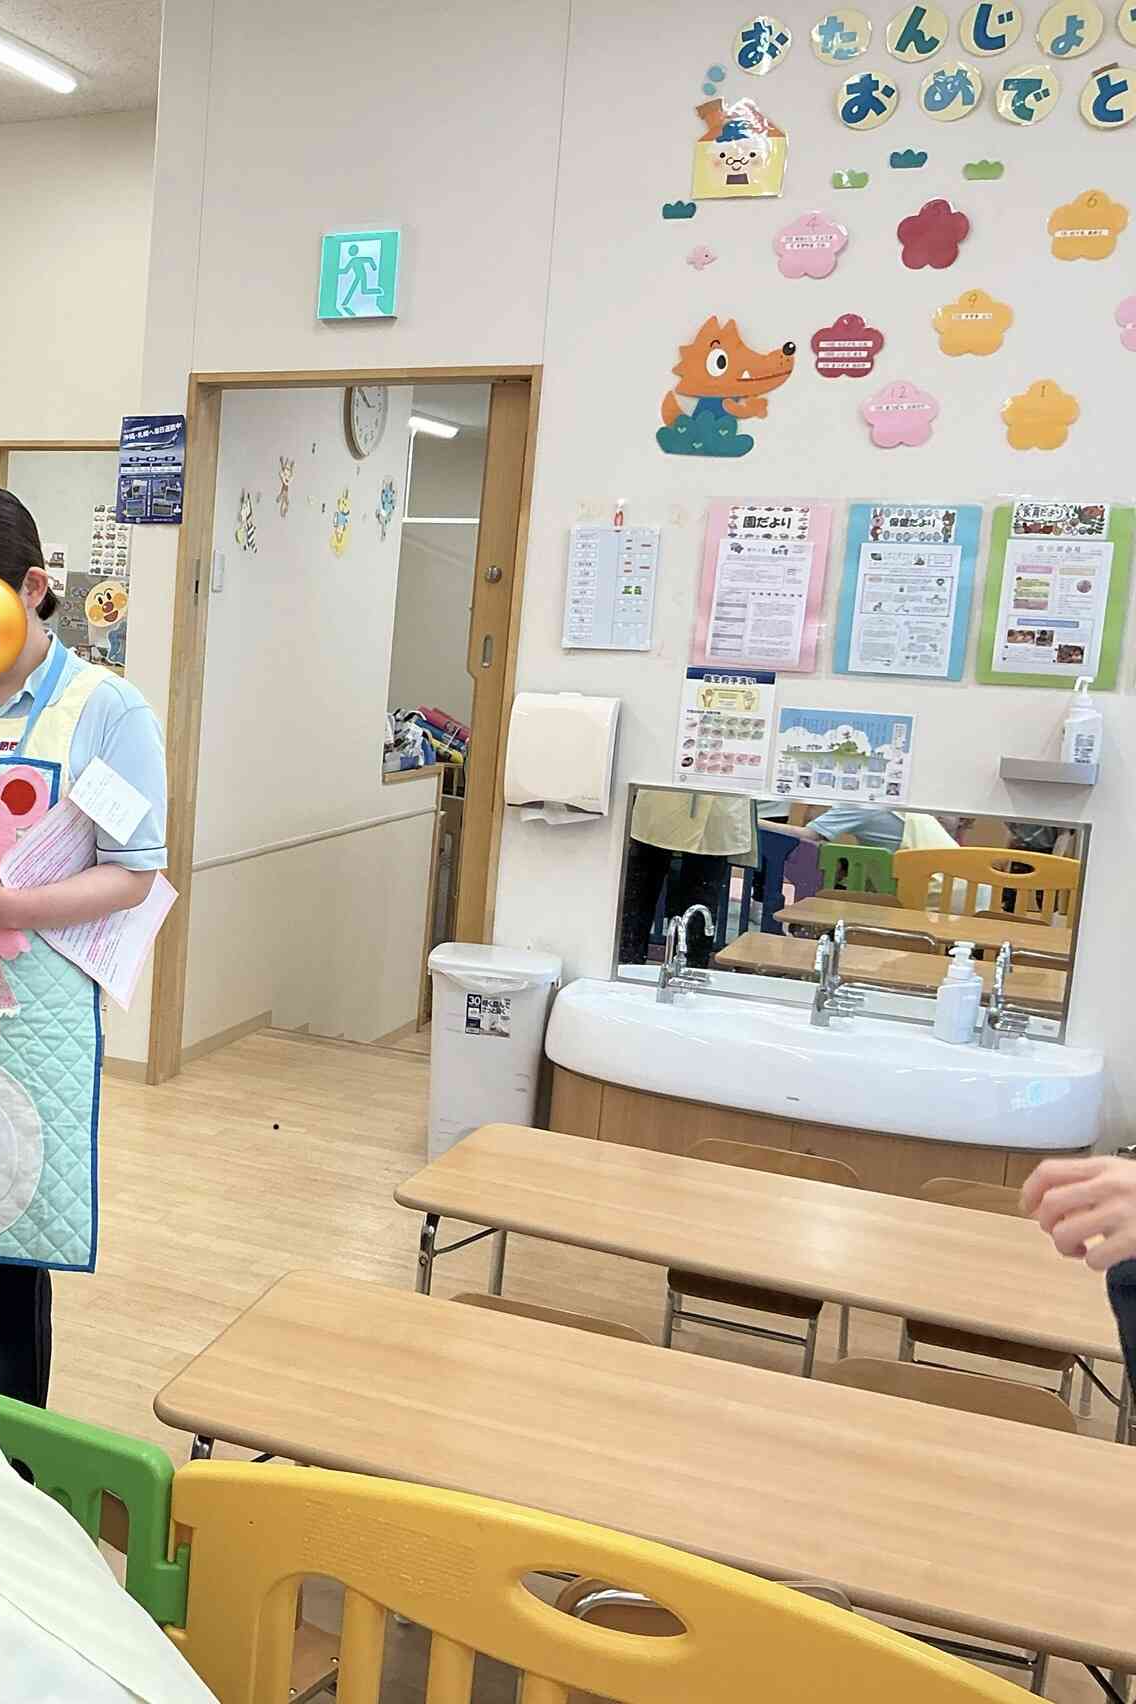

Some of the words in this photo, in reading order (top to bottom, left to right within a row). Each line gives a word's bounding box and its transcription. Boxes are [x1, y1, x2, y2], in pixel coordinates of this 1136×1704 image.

[738, 3, 1136, 69] おたんじょ
[1087, 192, 1098, 209] 6
[1023, 506, 1064, 519] 食育だより
[742, 516, 792, 529] 園だより
[889, 517, 936, 528] 保健だより
[468, 995, 481, 1005] 30
